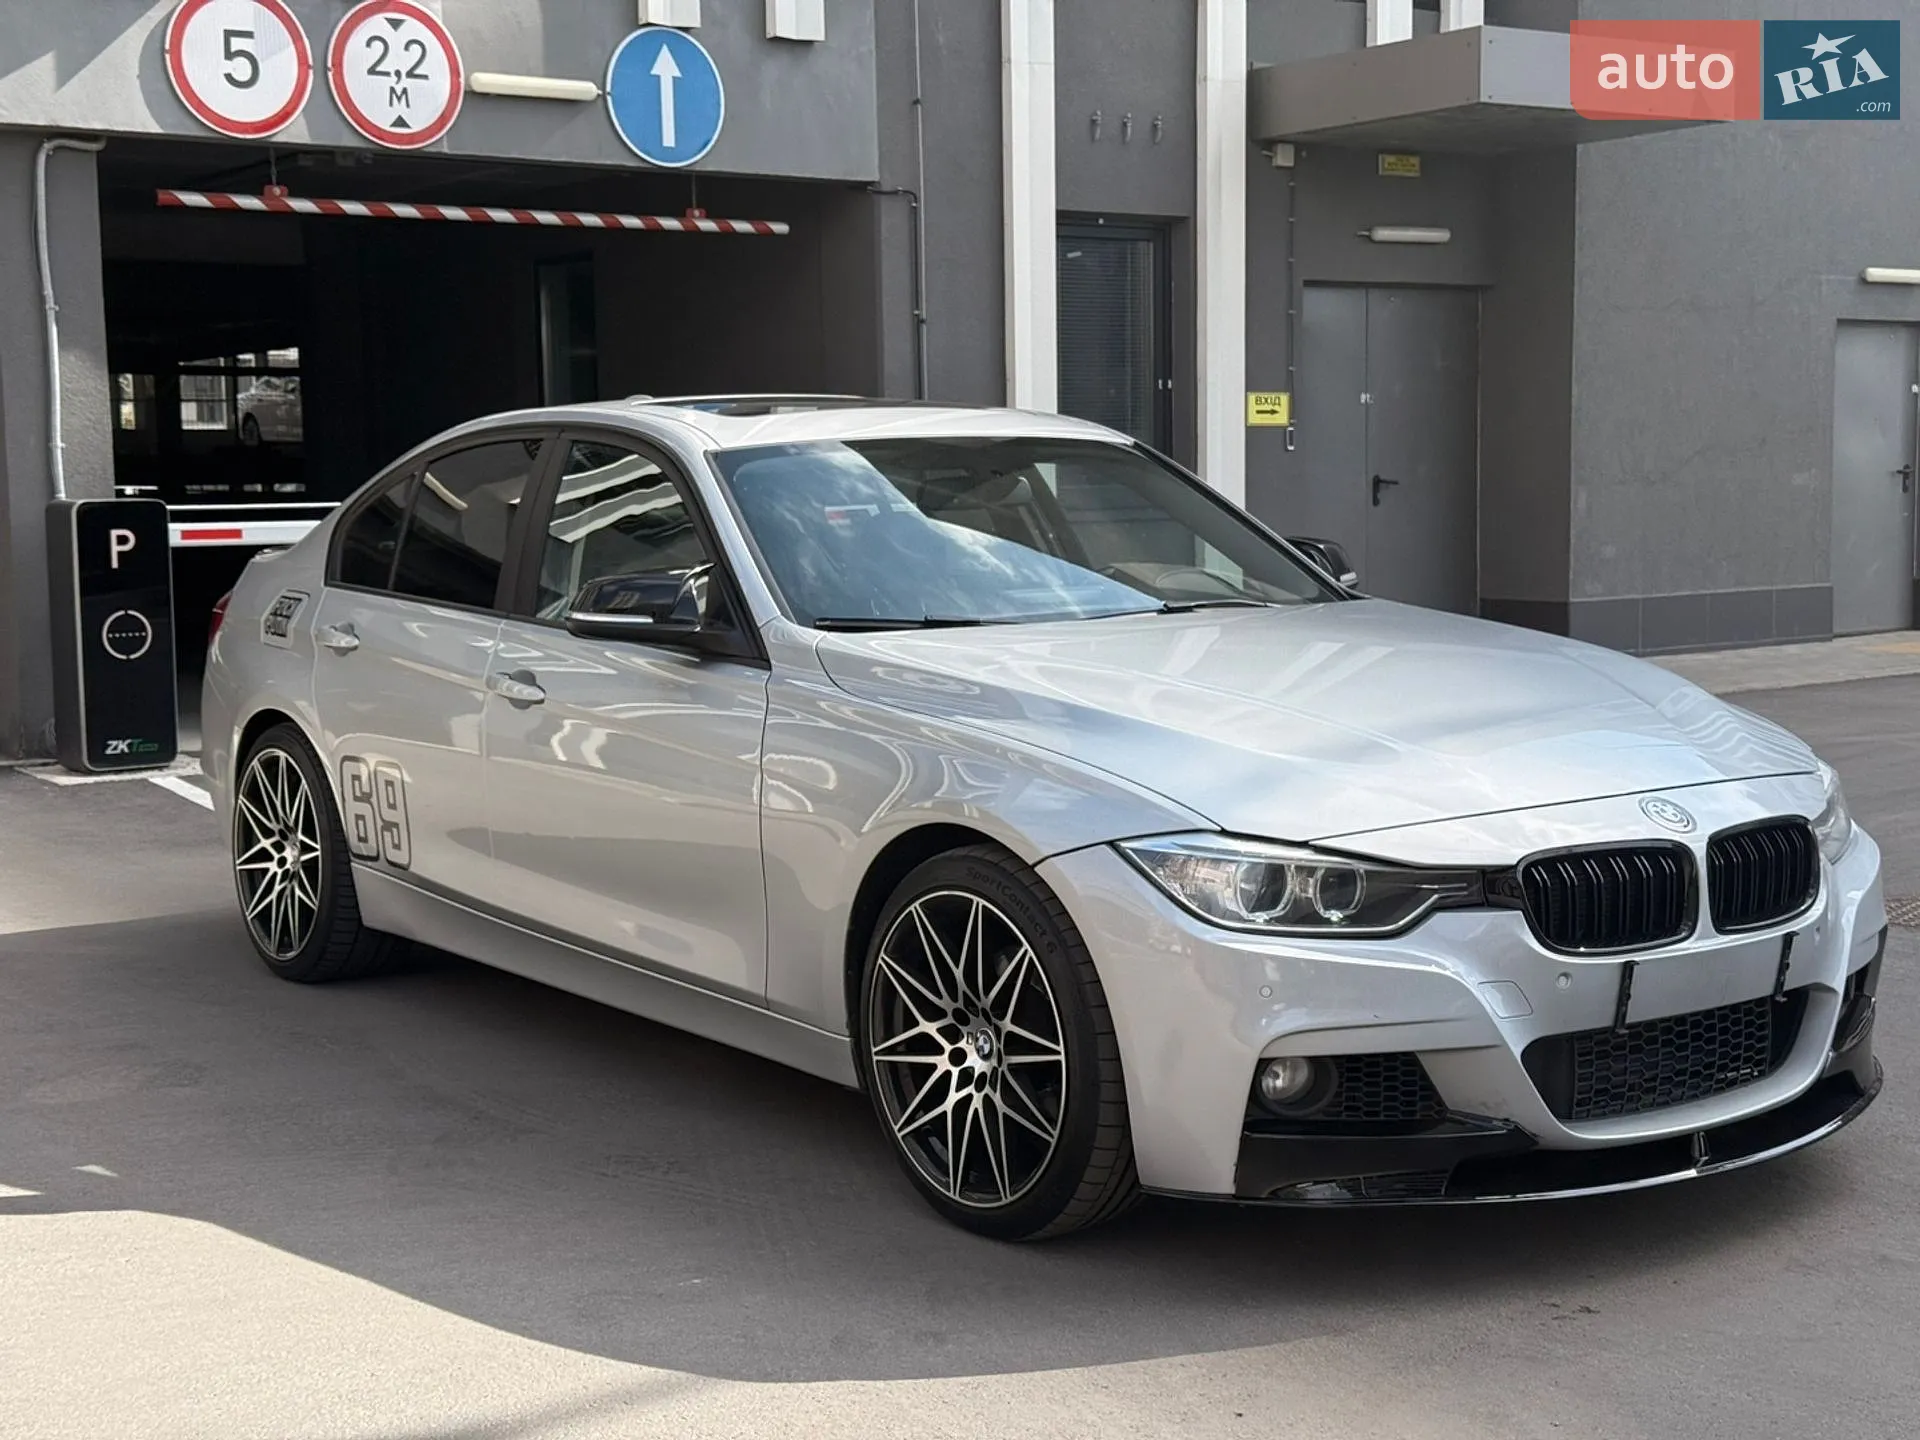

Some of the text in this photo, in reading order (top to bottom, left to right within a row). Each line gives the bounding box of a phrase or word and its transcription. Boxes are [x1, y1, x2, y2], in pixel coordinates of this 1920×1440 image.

[223, 29, 260, 89] 5
[365, 35, 429, 85] 2,2
[1255, 395, 1281, 407] ВХІД
[109, 528, 136, 569] P
[104, 738, 160, 755] ZKT
[340, 755, 412, 871] 69
[966, 867, 1047, 938] SportContact
